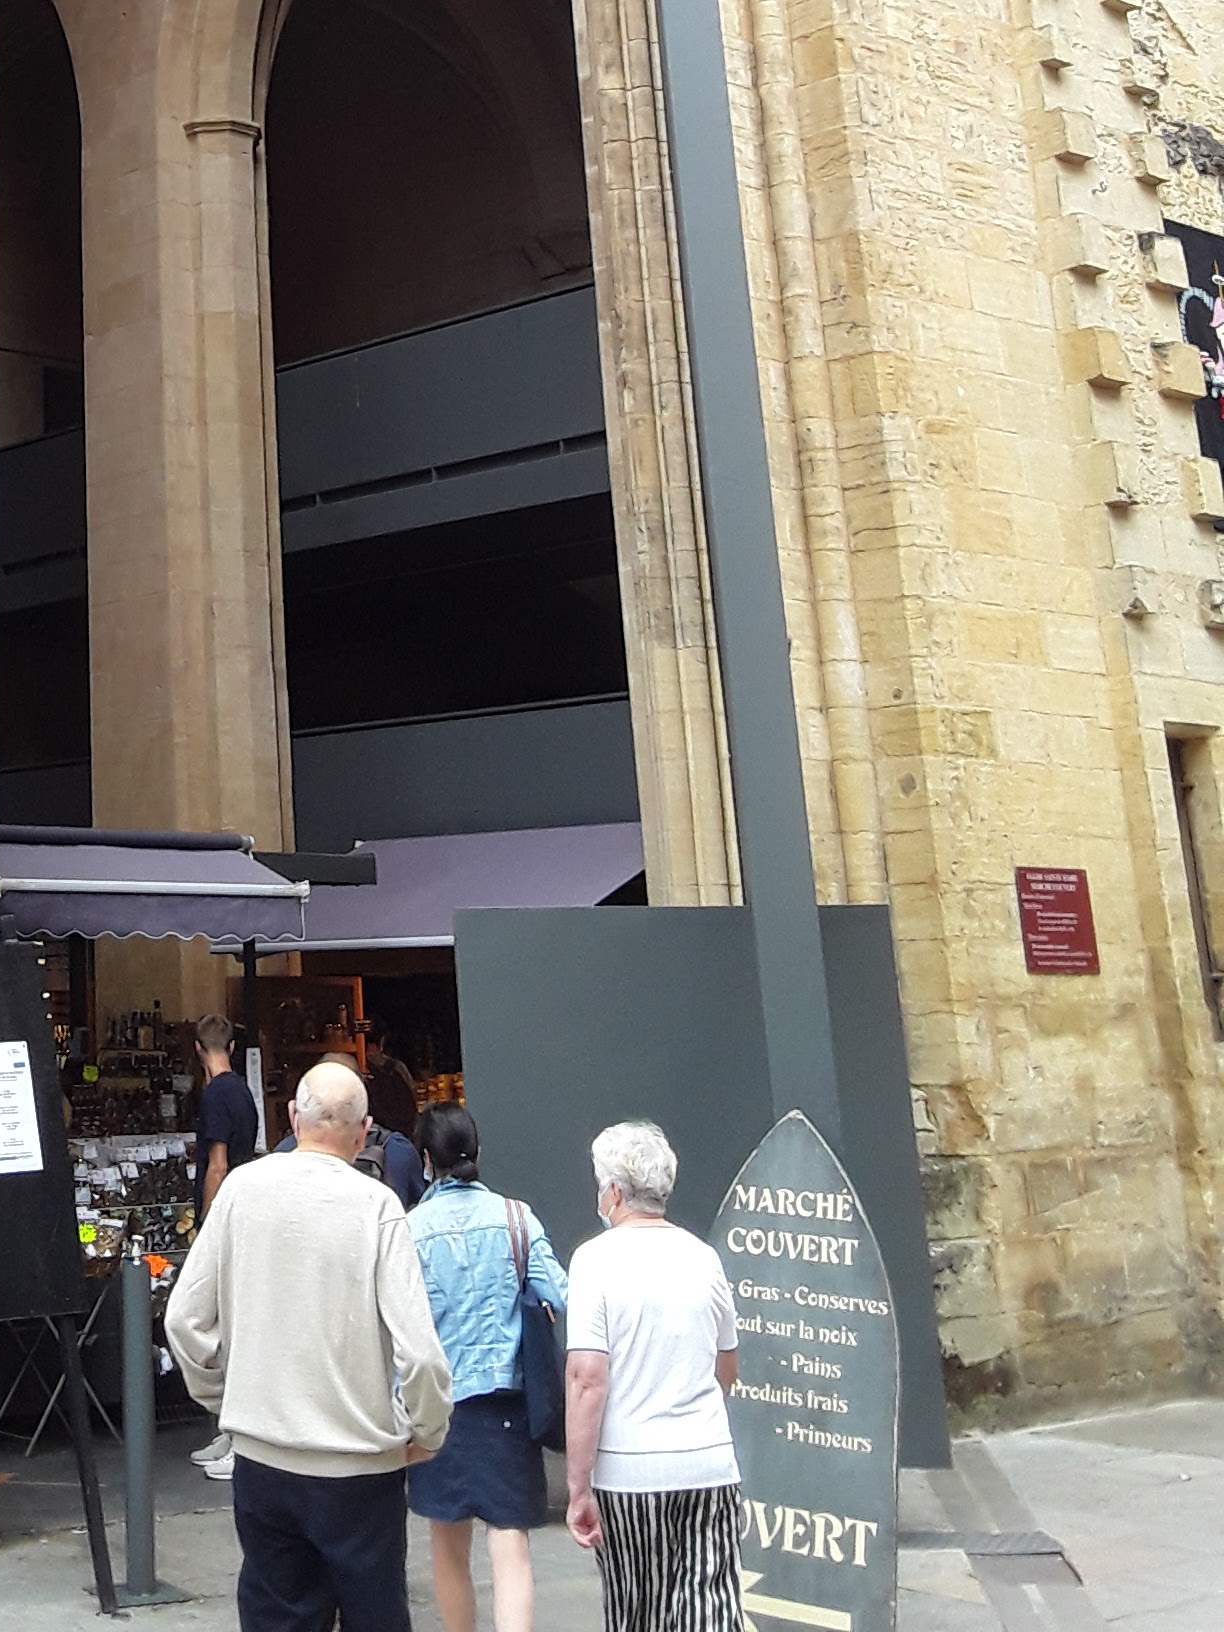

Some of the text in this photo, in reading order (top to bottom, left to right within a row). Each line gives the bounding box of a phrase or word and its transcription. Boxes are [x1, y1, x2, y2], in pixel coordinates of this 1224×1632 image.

[733, 1184, 854, 1222] MARCHÉ
[727, 1226, 859, 1266] COUVERT
[738, 1279, 781, 1301] Gras
[794, 1285, 890, 1316] Conserves
[735, 1314, 858, 1347] out sur la noix
[791, 1352, 843, 1379] Pains
[729, 1377, 849, 1414] Produits frais
[786, 1420, 873, 1454] Primeurs
